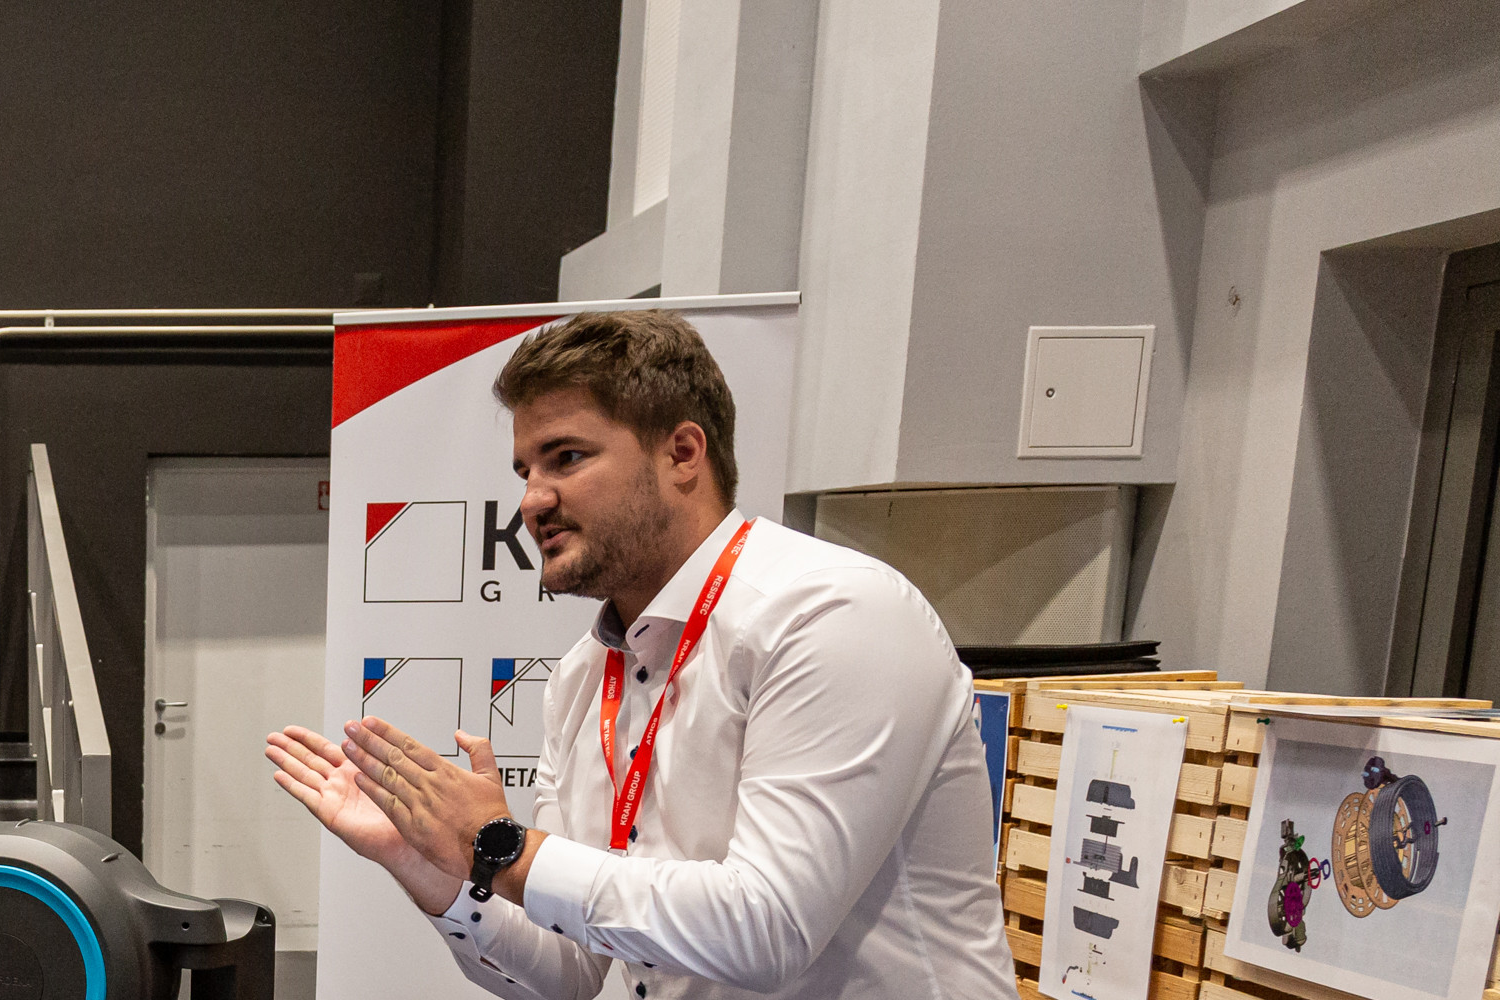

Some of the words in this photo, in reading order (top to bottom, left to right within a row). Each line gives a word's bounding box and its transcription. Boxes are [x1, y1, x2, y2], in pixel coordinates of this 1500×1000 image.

[700, 575, 723, 615] RESISTEC
[607, 675, 617, 700] ATHOS
[646, 717, 658, 746] ATHOS
[498, 768, 537, 787] ETA
[619, 802, 632, 826] KRAH
[628, 770, 642, 801] GROUP
